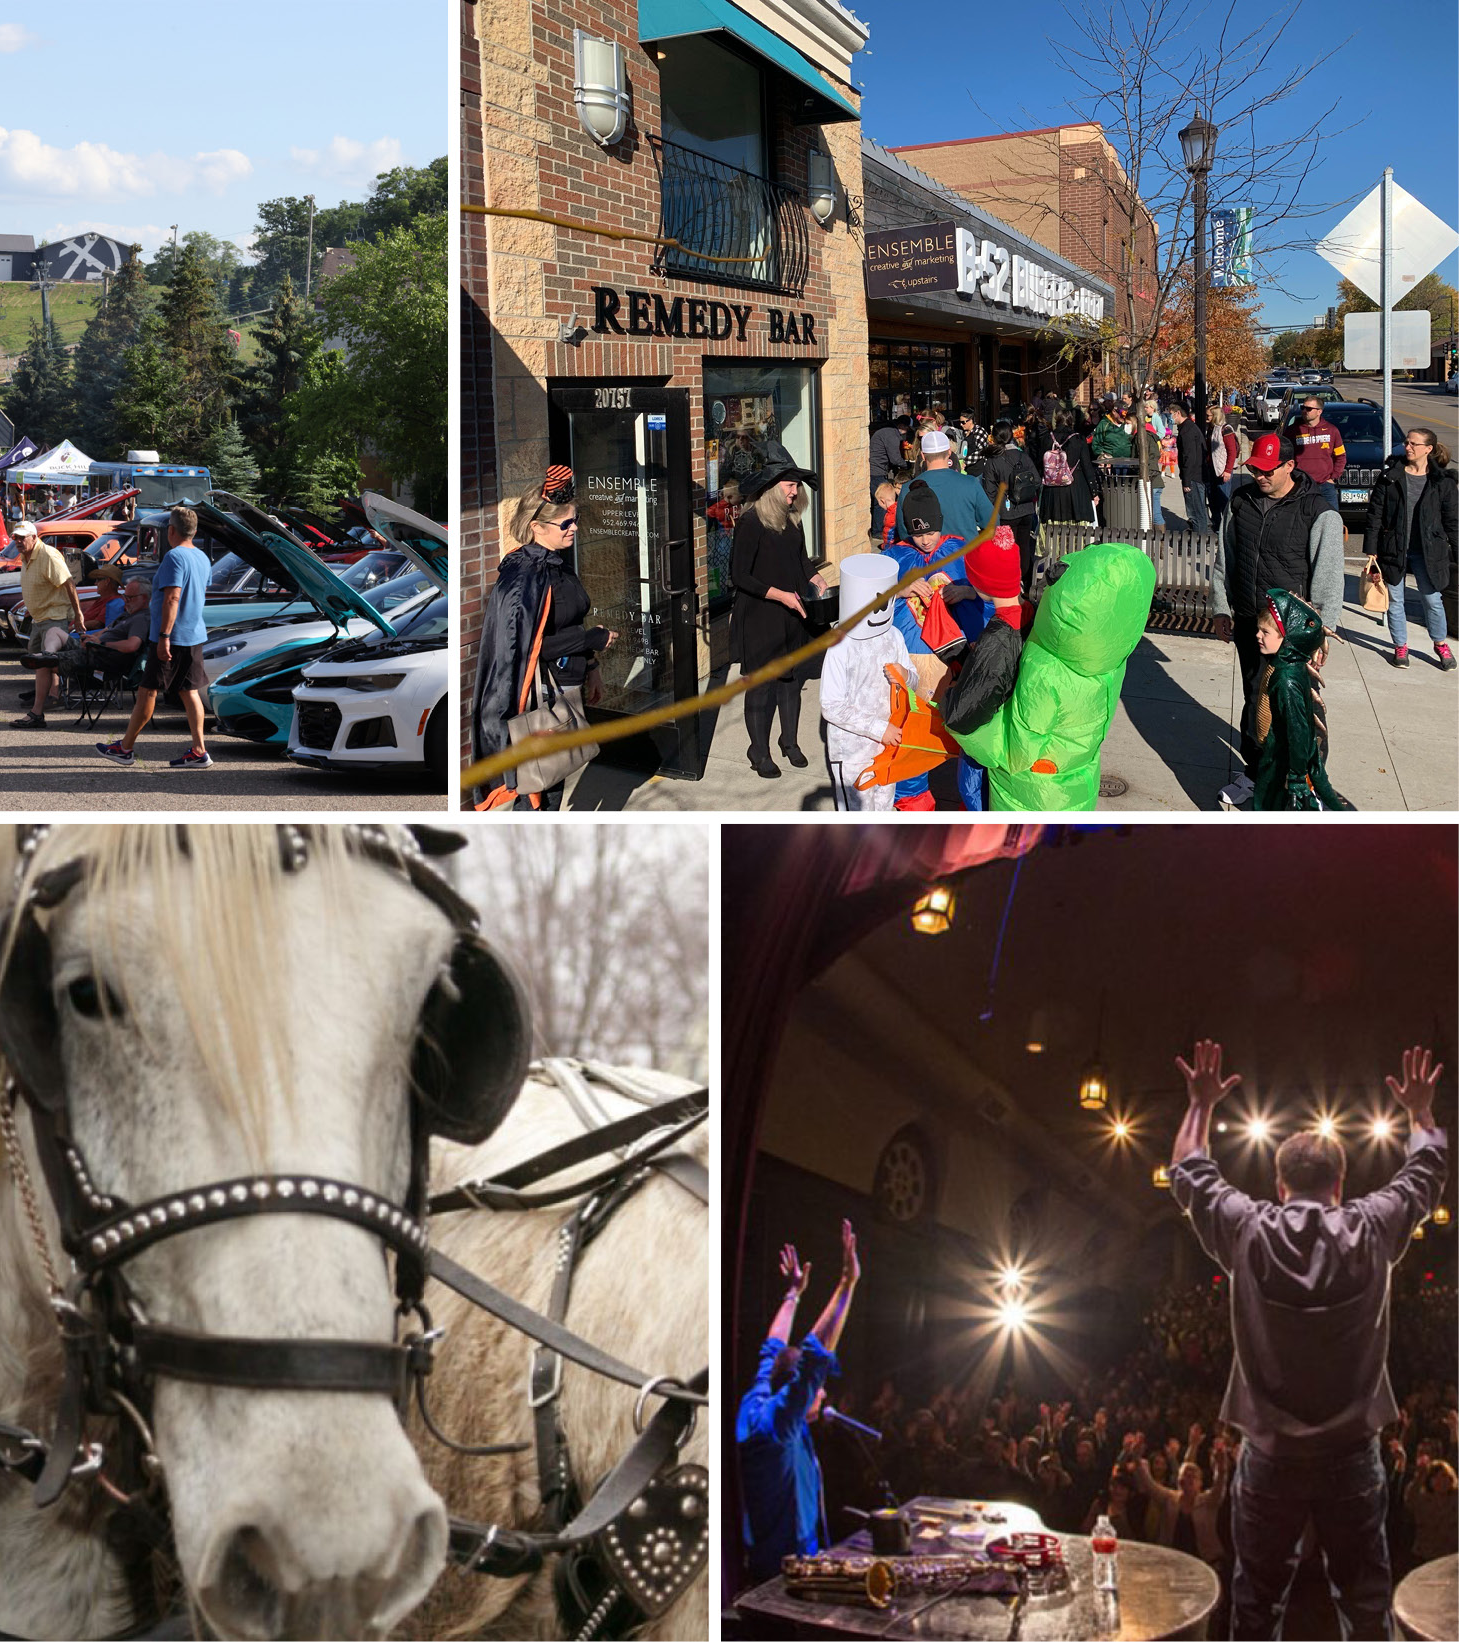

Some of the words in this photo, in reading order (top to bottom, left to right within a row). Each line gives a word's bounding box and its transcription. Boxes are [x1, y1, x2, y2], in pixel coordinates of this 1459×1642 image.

[868, 234, 954, 260] ENSEMBLE
[1213, 219, 1224, 278] Welcome
[870, 260, 900, 272] creative
[914, 253, 955, 265] marketing
[907, 275, 938, 288] upstairs
[591, 286, 752, 342] REMEDY
[768, 308, 817, 345] BAR
[588, 475, 658, 492] ENSEMBLE
[588, 492, 613, 501] creative
[625, 494, 658, 506] maring
[602, 509, 623, 517] UPPER
[624, 510, 640, 518] LEV
